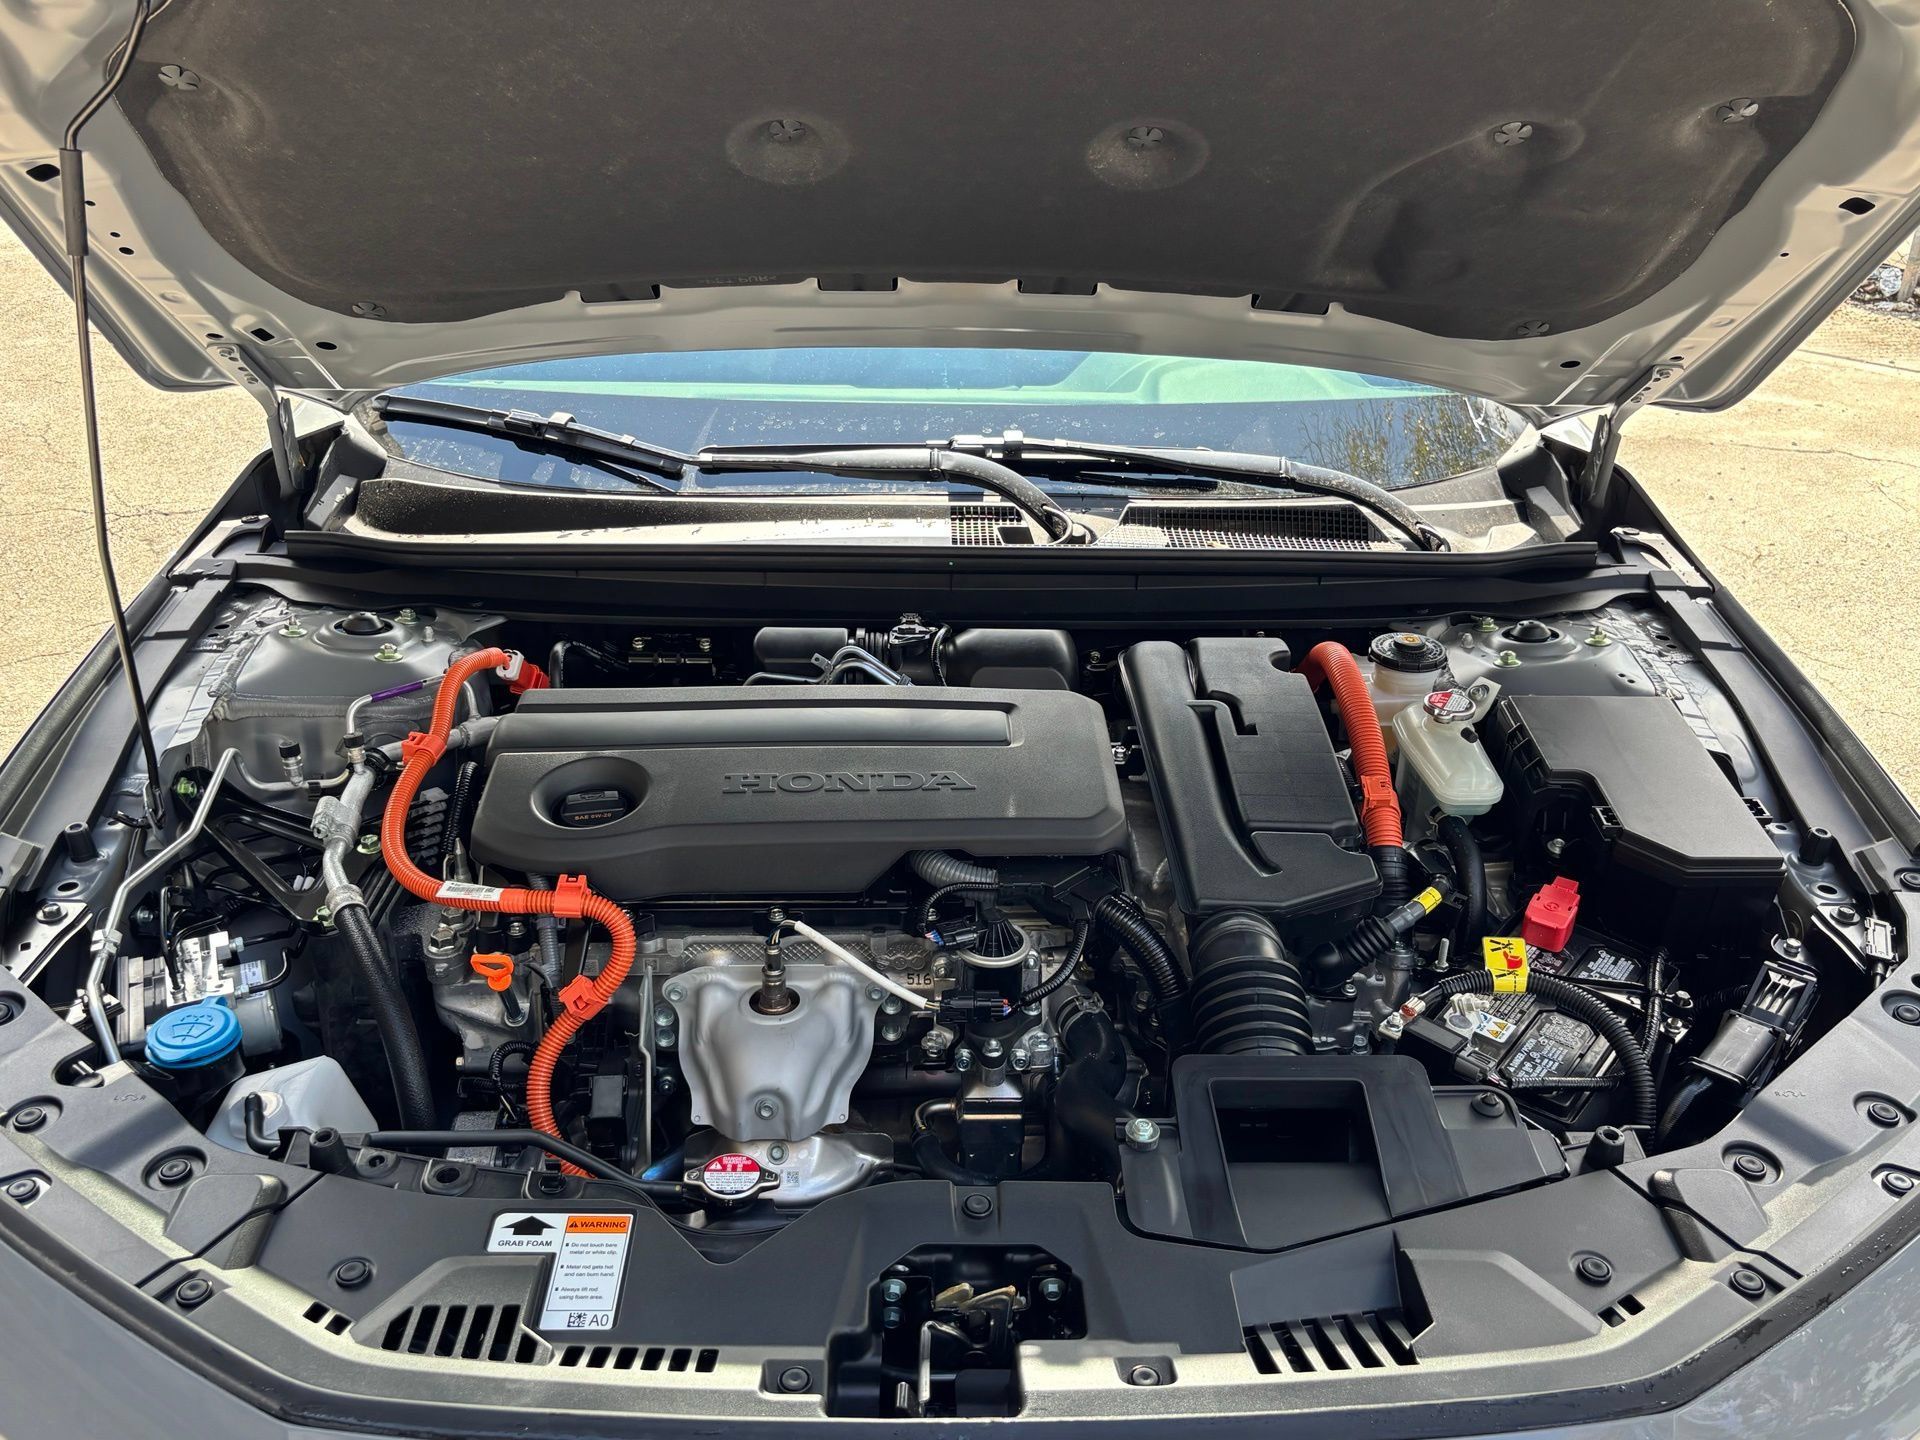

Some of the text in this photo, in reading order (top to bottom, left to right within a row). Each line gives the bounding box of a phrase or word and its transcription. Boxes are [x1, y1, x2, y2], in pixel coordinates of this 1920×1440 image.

[722, 771, 976, 794] HONDA
[906, 973, 932, 986] 516
[580, 1221, 626, 1229] WARNING
[588, 1314, 609, 1327] A0
